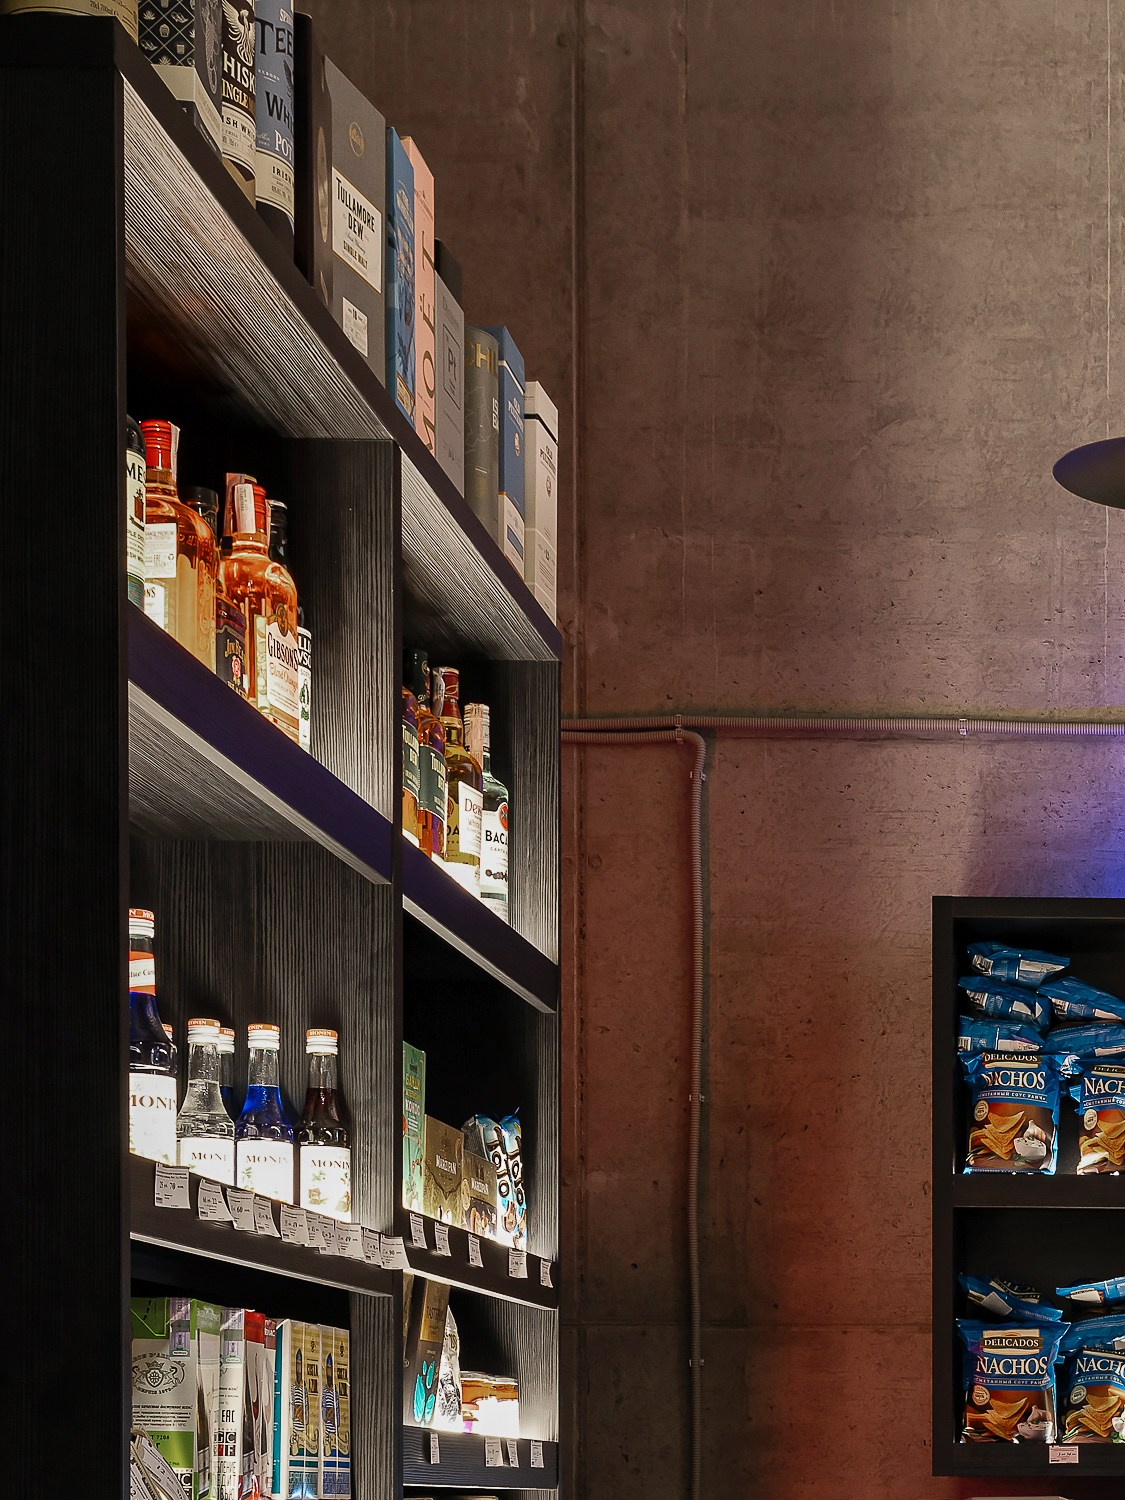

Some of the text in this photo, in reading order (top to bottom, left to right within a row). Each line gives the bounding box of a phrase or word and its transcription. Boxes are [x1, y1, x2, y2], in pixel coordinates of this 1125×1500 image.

[336, 176, 376, 233] TULLAMORE
[348, 212, 364, 241] DEW
[984, 1053, 1038, 1062] DELICADOS
[981, 1070, 1046, 1090] NACHOS
[984, 1338, 1040, 1348] DELICADOS
[976, 1356, 1048, 1376] NACHOS
